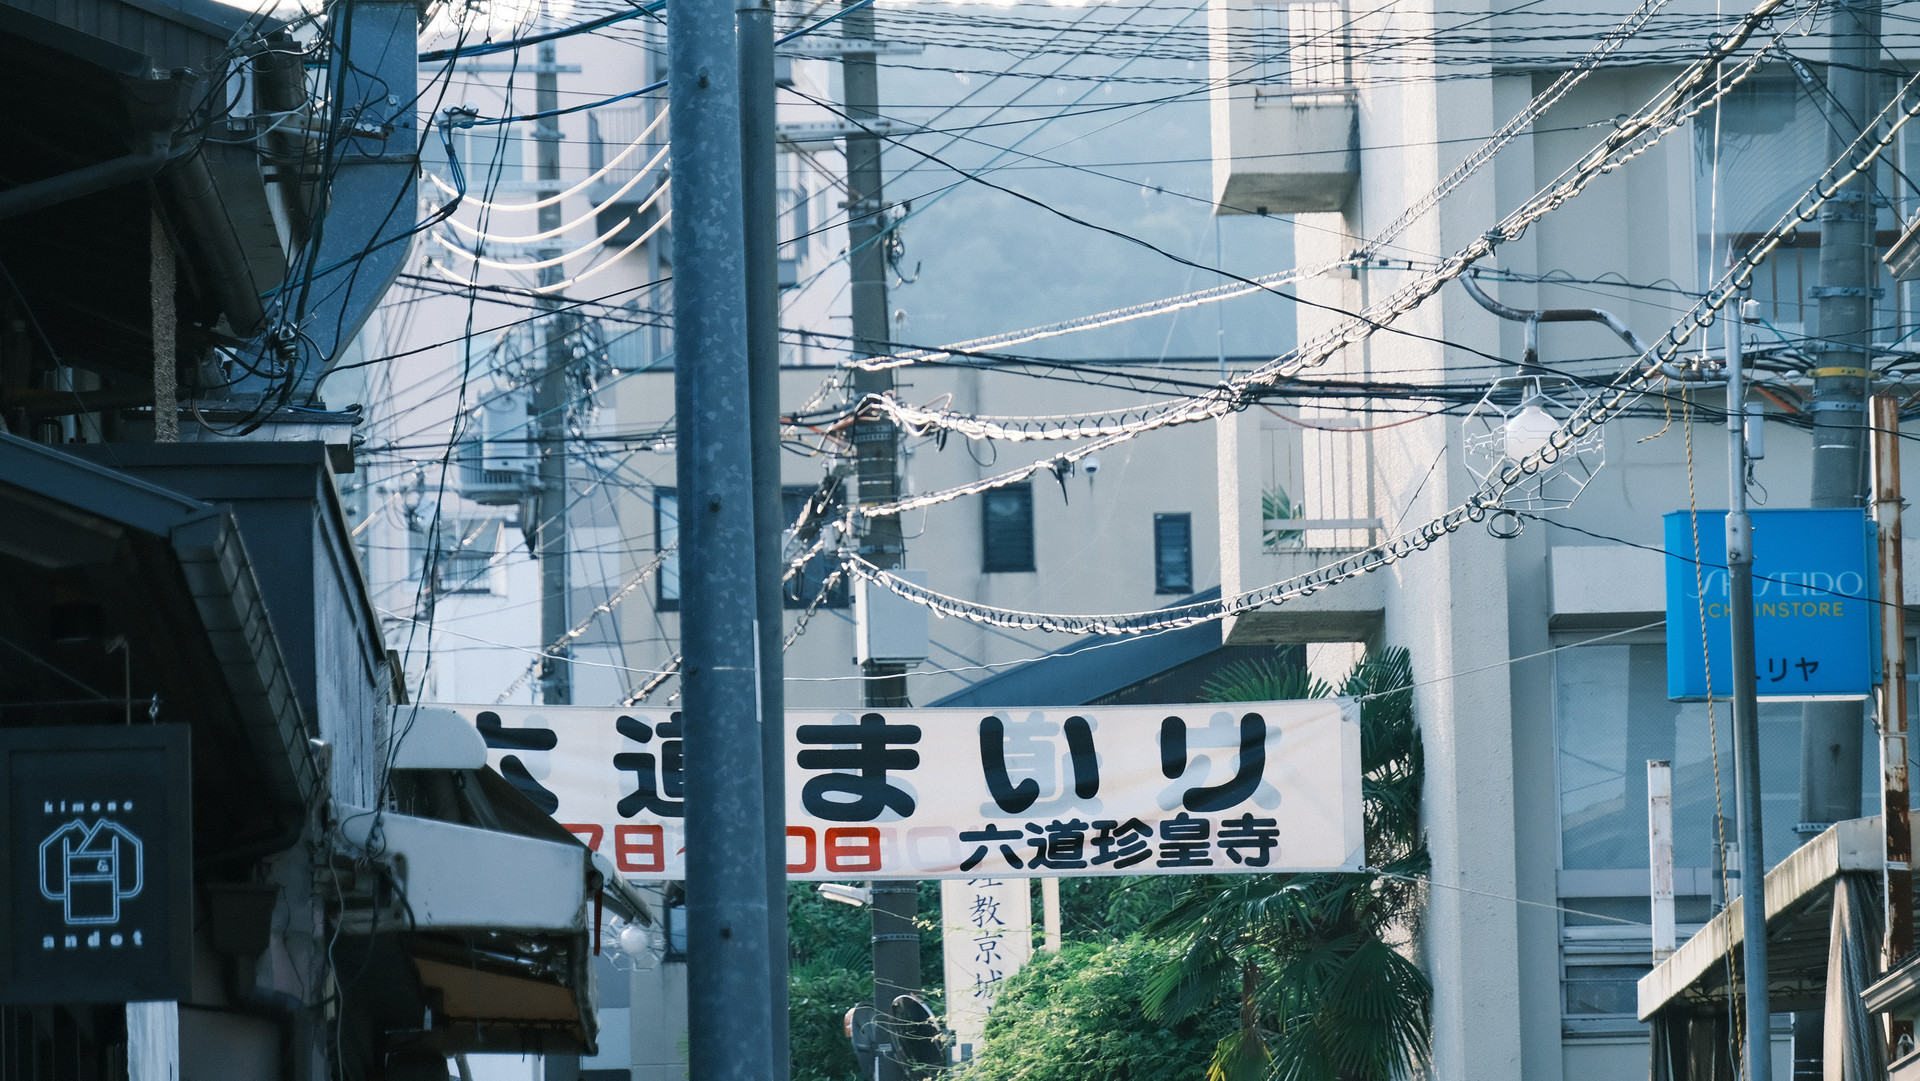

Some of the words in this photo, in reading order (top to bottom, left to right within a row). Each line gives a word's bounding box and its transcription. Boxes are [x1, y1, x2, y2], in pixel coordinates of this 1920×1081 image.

[1686, 570, 1863, 598] SSEIDO
[1708, 602, 1844, 618] CHINSTORE
[1755, 657, 1819, 682] リヤ
[44, 800, 133, 813] kimono
[959, 812, 1280, 872] 六道珍皇寺
[43, 929, 143, 948] andot
